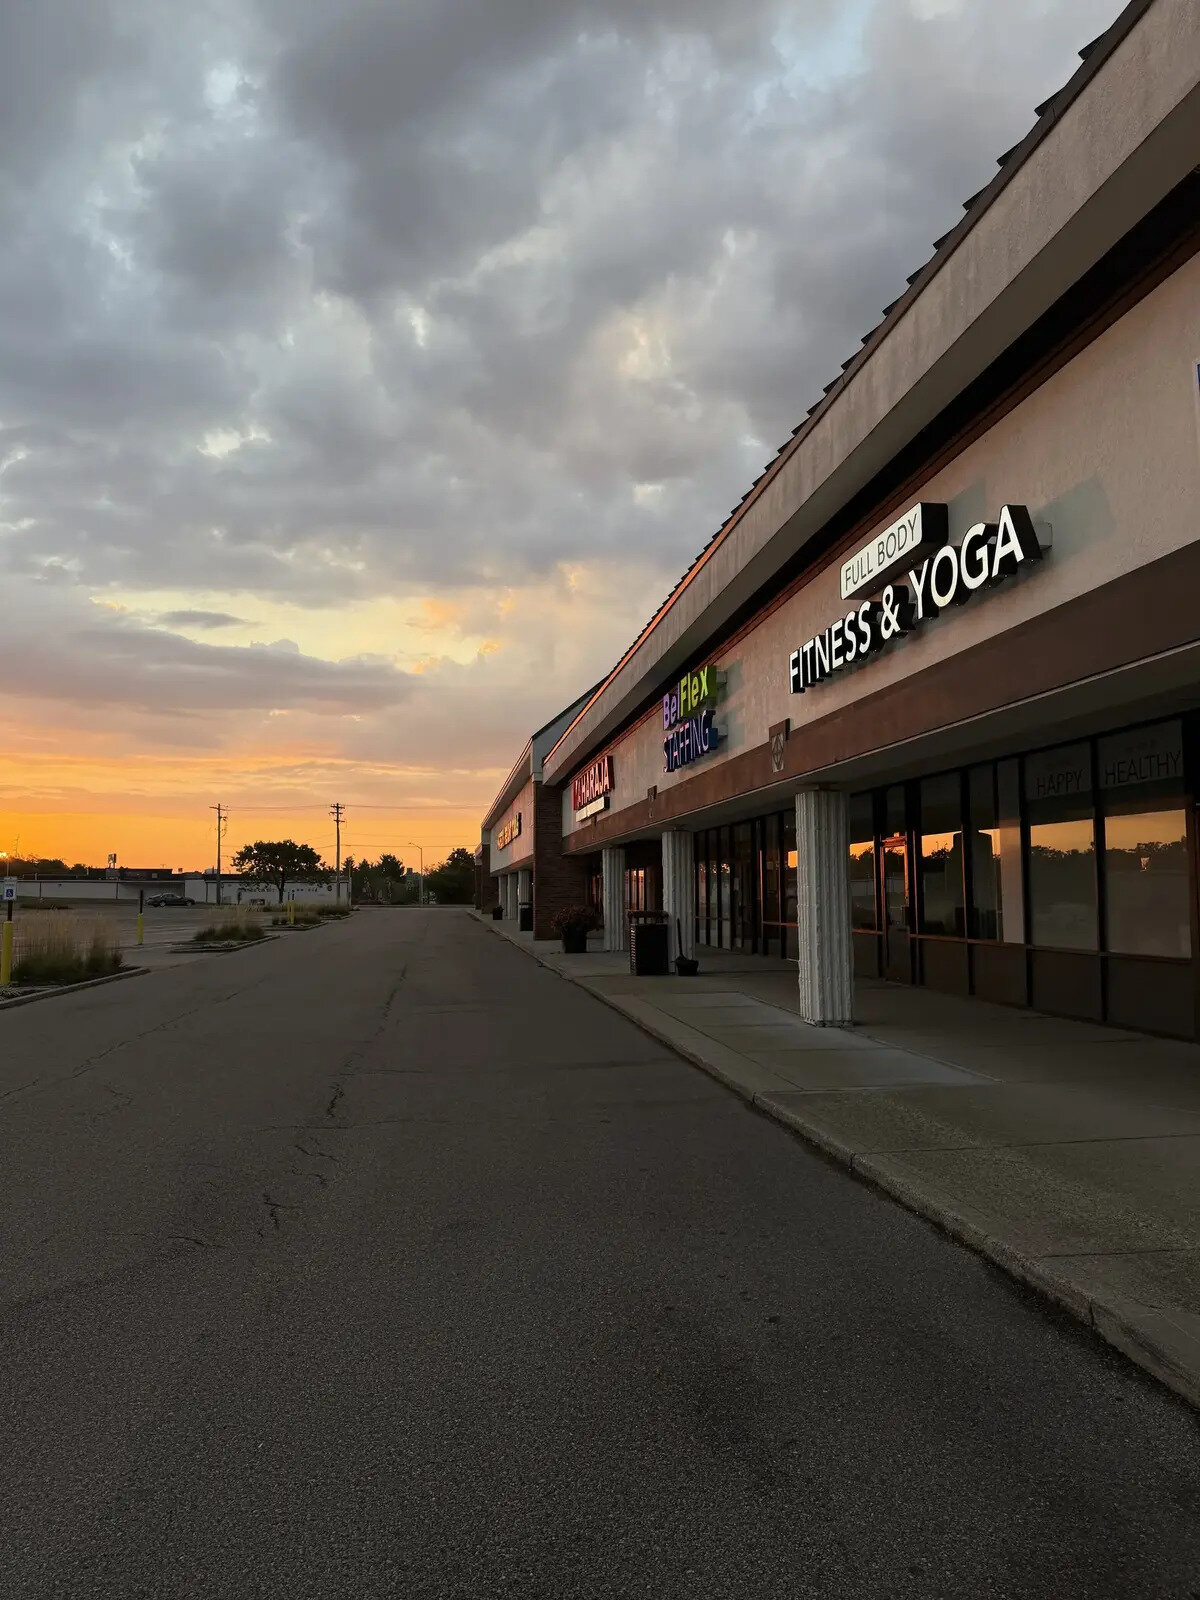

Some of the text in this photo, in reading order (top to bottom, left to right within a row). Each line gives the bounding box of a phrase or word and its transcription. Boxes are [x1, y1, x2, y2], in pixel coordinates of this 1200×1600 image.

[844, 512, 918, 592] FULL BODY
[789, 504, 1025, 694] FITNESS & YOGA
[1036, 767, 1085, 797] HAPPY
[1104, 749, 1183, 786] HEALTHY
